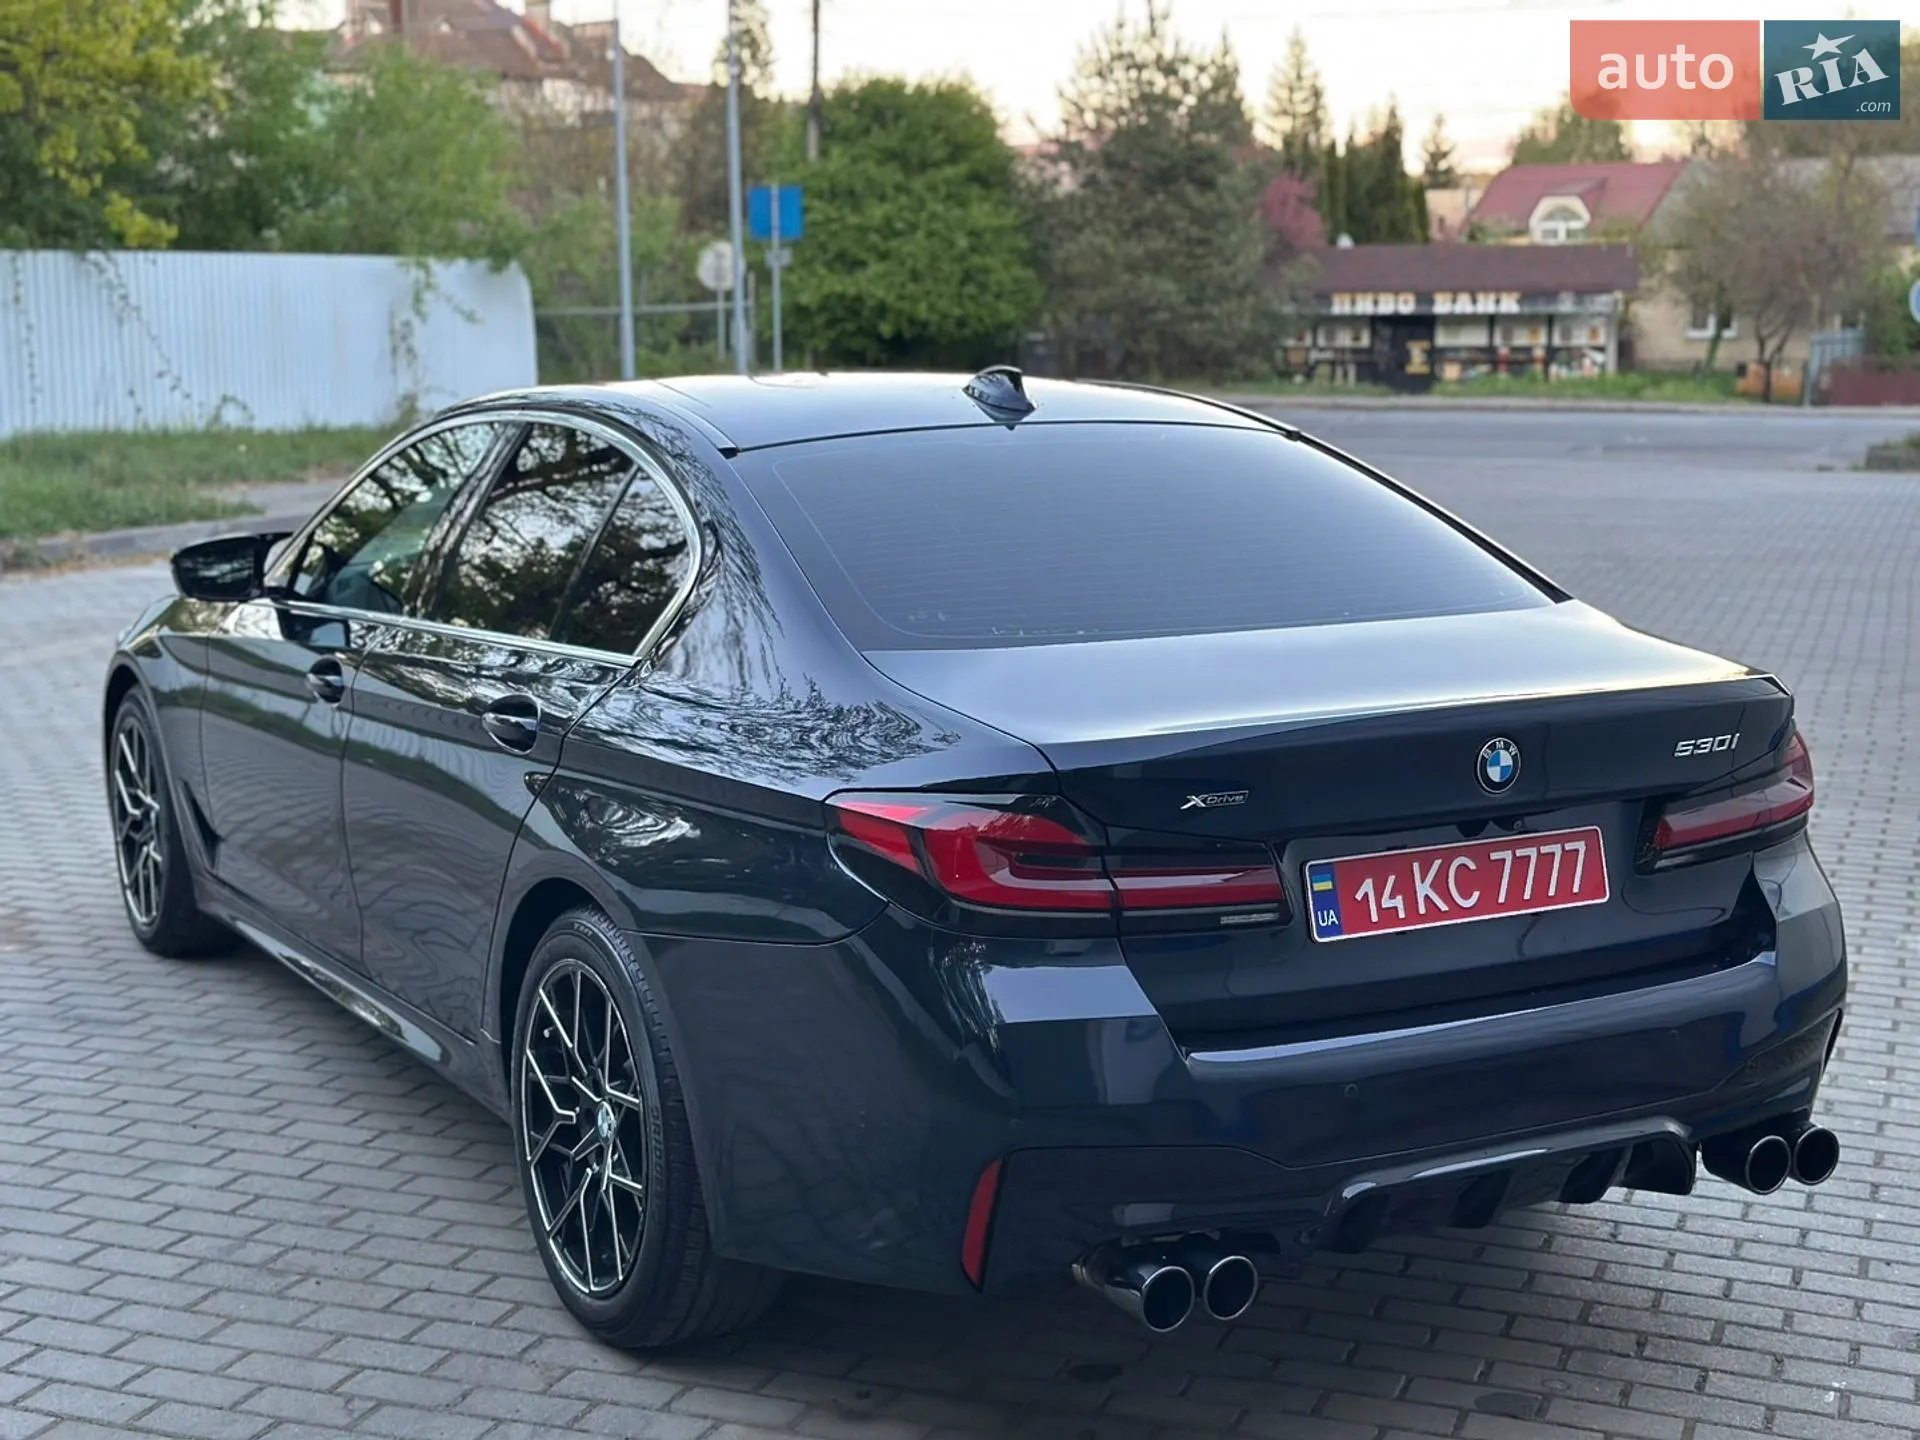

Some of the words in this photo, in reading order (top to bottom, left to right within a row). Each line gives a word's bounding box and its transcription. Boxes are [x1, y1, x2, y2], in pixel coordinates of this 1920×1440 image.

[1673, 732, 1740, 758] 530i
[1354, 865, 1406, 923] 14
[1413, 856, 1480, 915] KC
[1489, 840, 1586, 904] 7777
[1317, 910, 1339, 927] UA
